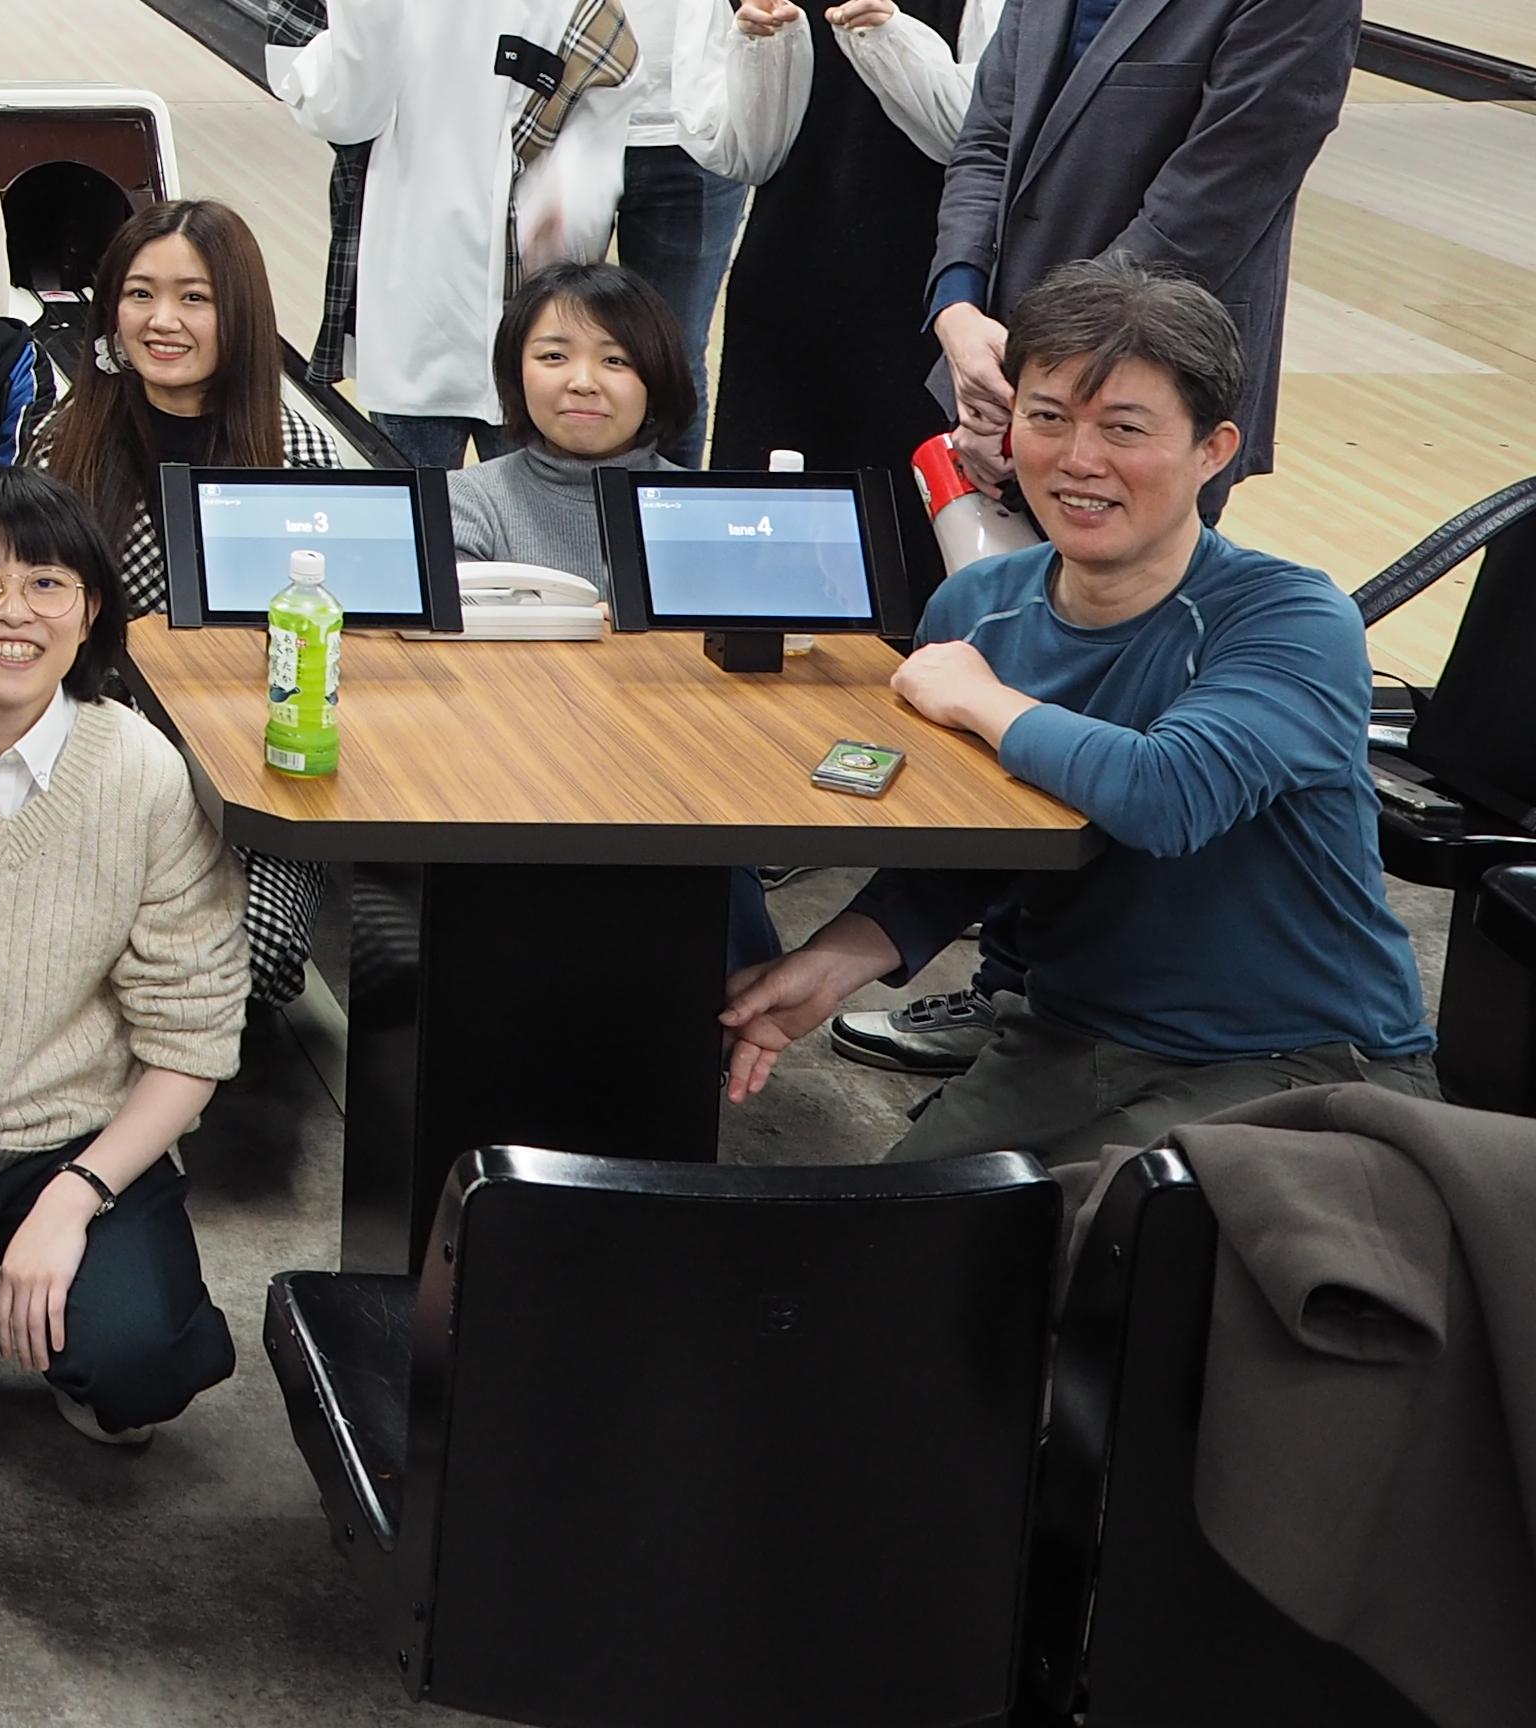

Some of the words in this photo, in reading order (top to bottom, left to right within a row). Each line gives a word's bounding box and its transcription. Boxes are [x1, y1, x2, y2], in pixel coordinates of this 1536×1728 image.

[285, 519, 313, 533] lane
[313, 511, 329, 533] 3
[728, 522, 757, 536] lane
[756, 515, 774, 536] 4
